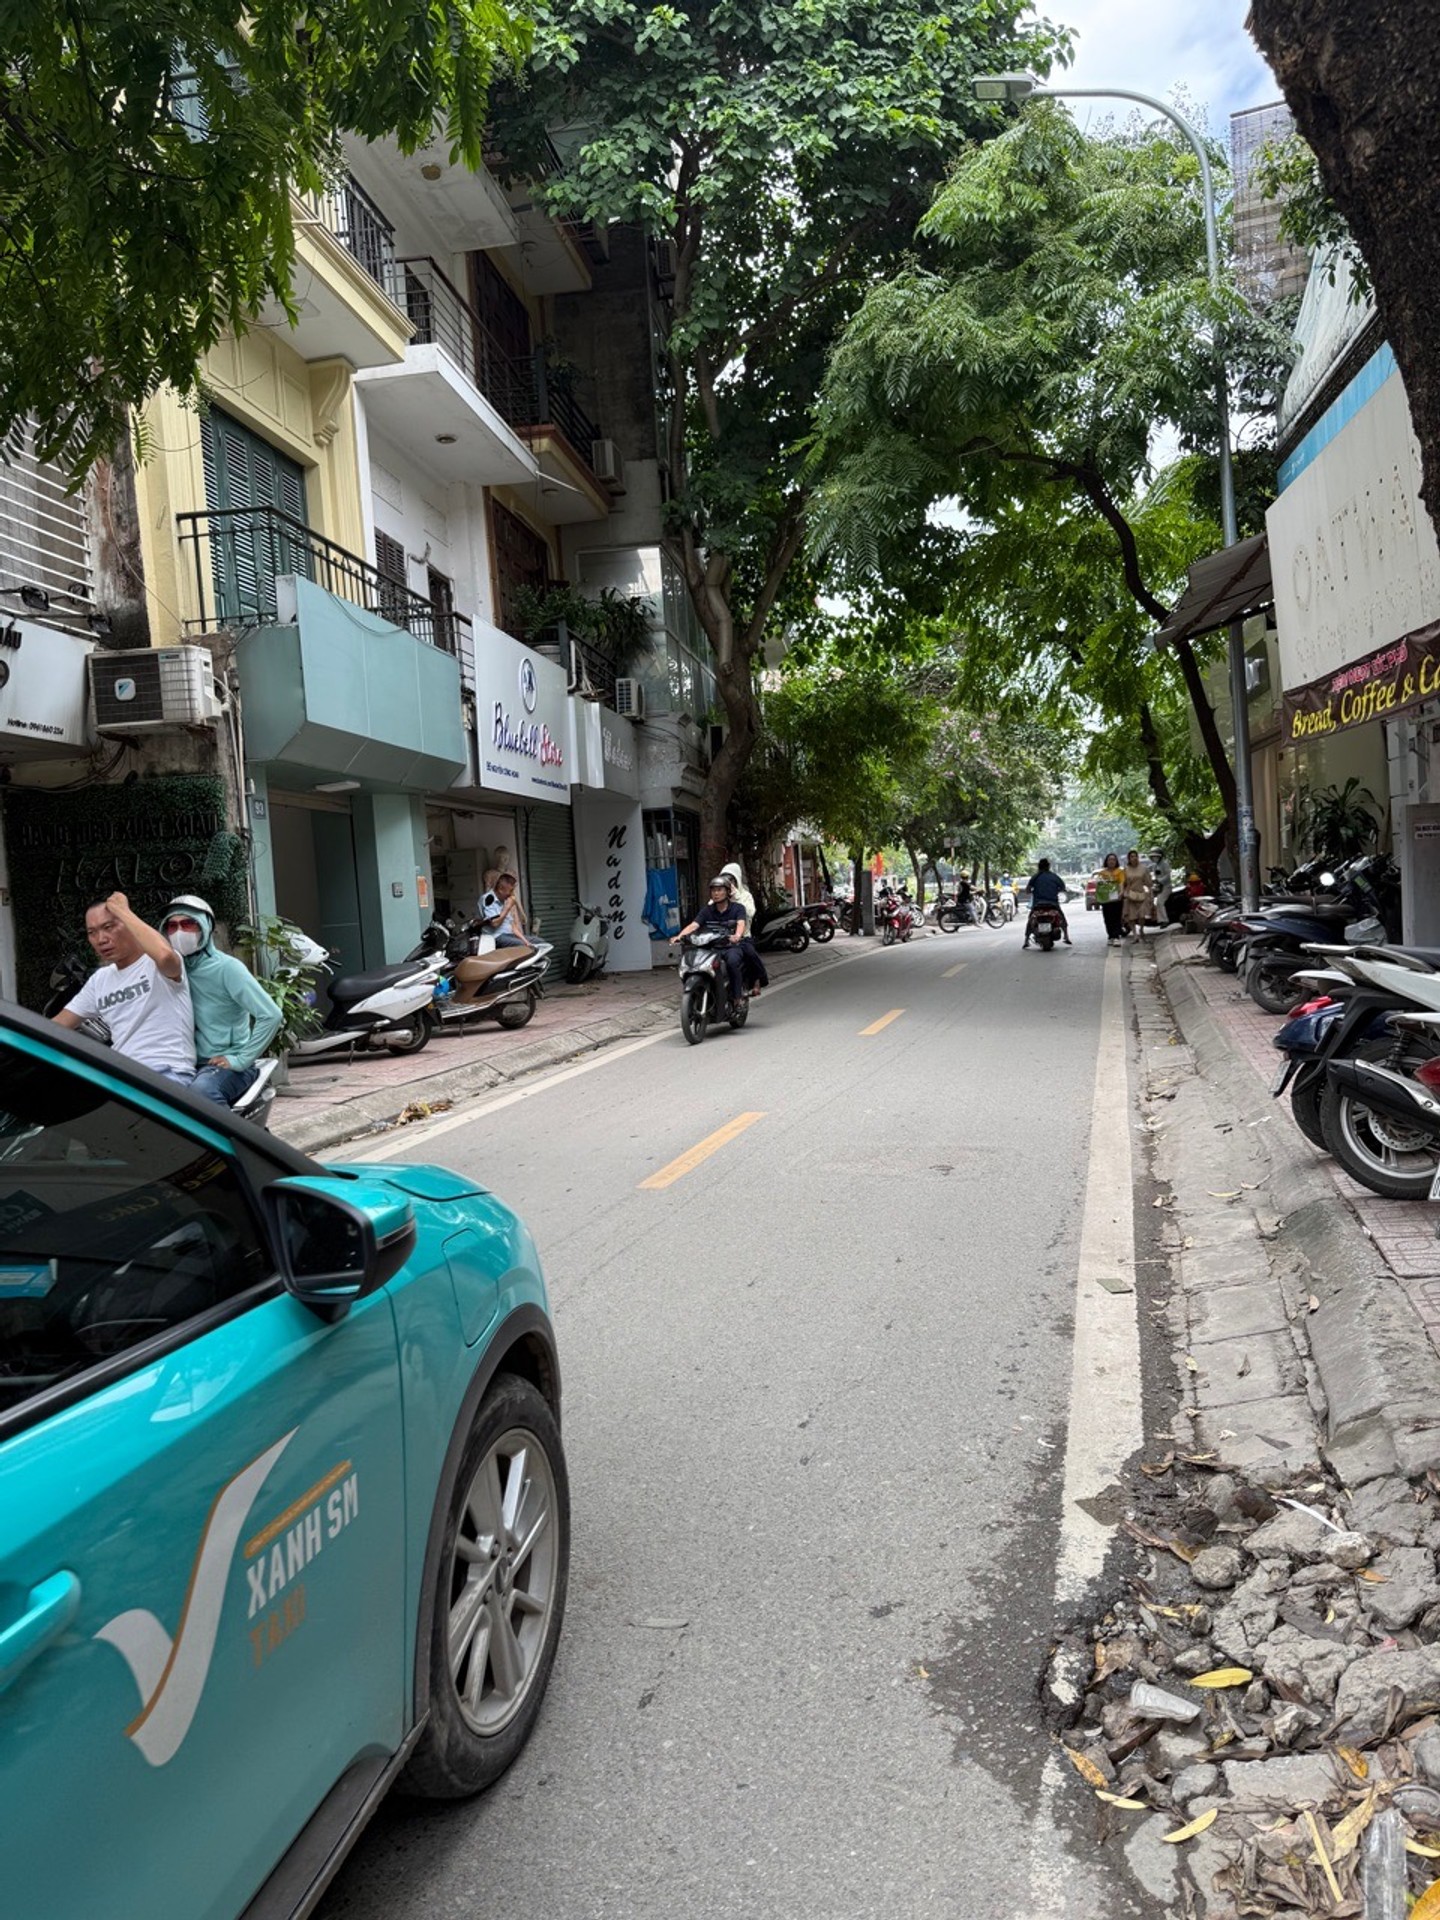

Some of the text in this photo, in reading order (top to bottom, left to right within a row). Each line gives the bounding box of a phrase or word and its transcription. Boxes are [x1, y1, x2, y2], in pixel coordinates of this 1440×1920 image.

[492, 700, 564, 767] Bluebell Store
[1291, 699, 1336, 738] Bread,
[1341, 679, 1396, 725] Coffee
[1400, 673, 1415, 705] &
[246, 1472, 359, 1619] XANH SM
